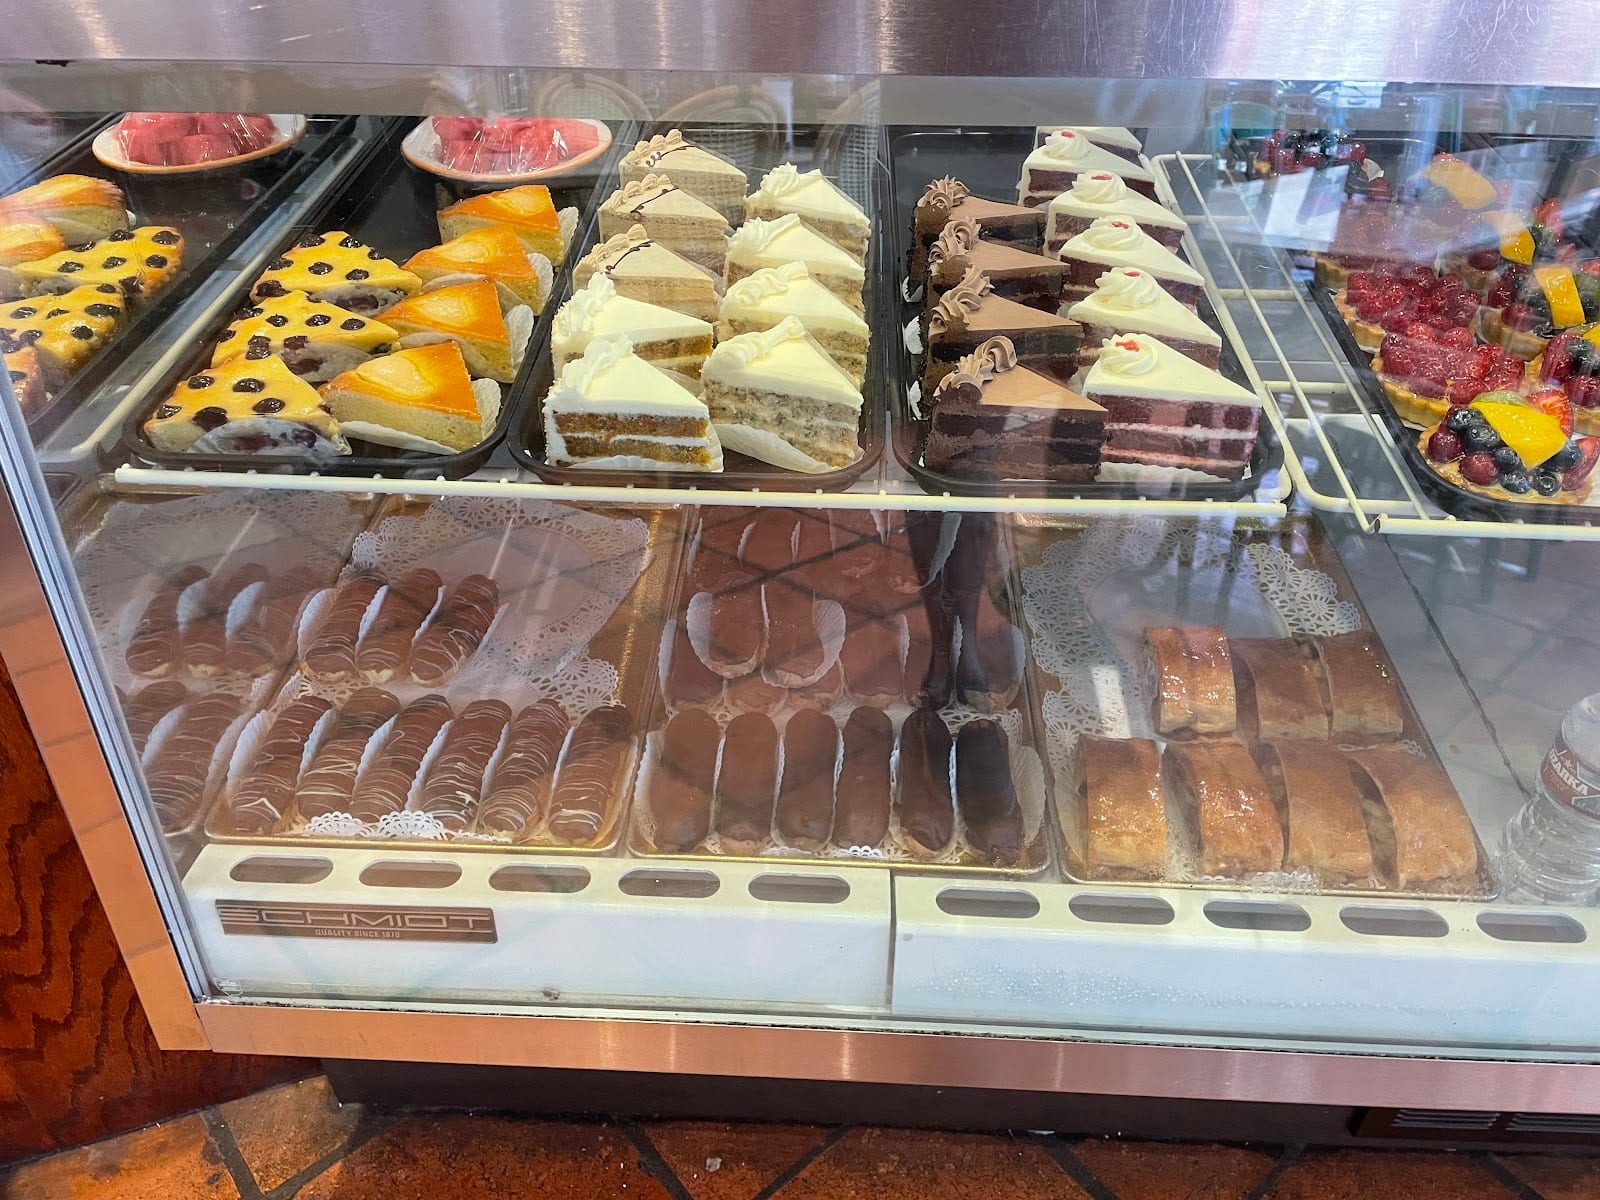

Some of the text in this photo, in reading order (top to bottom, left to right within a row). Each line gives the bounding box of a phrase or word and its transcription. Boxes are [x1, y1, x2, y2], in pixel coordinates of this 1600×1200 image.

[1550, 749, 1588, 796] OZARKA
[218, 908, 490, 929] SCHMIDT
[315, 928, 352, 937] QUALITY
[353, 929, 380, 938] SINCE
